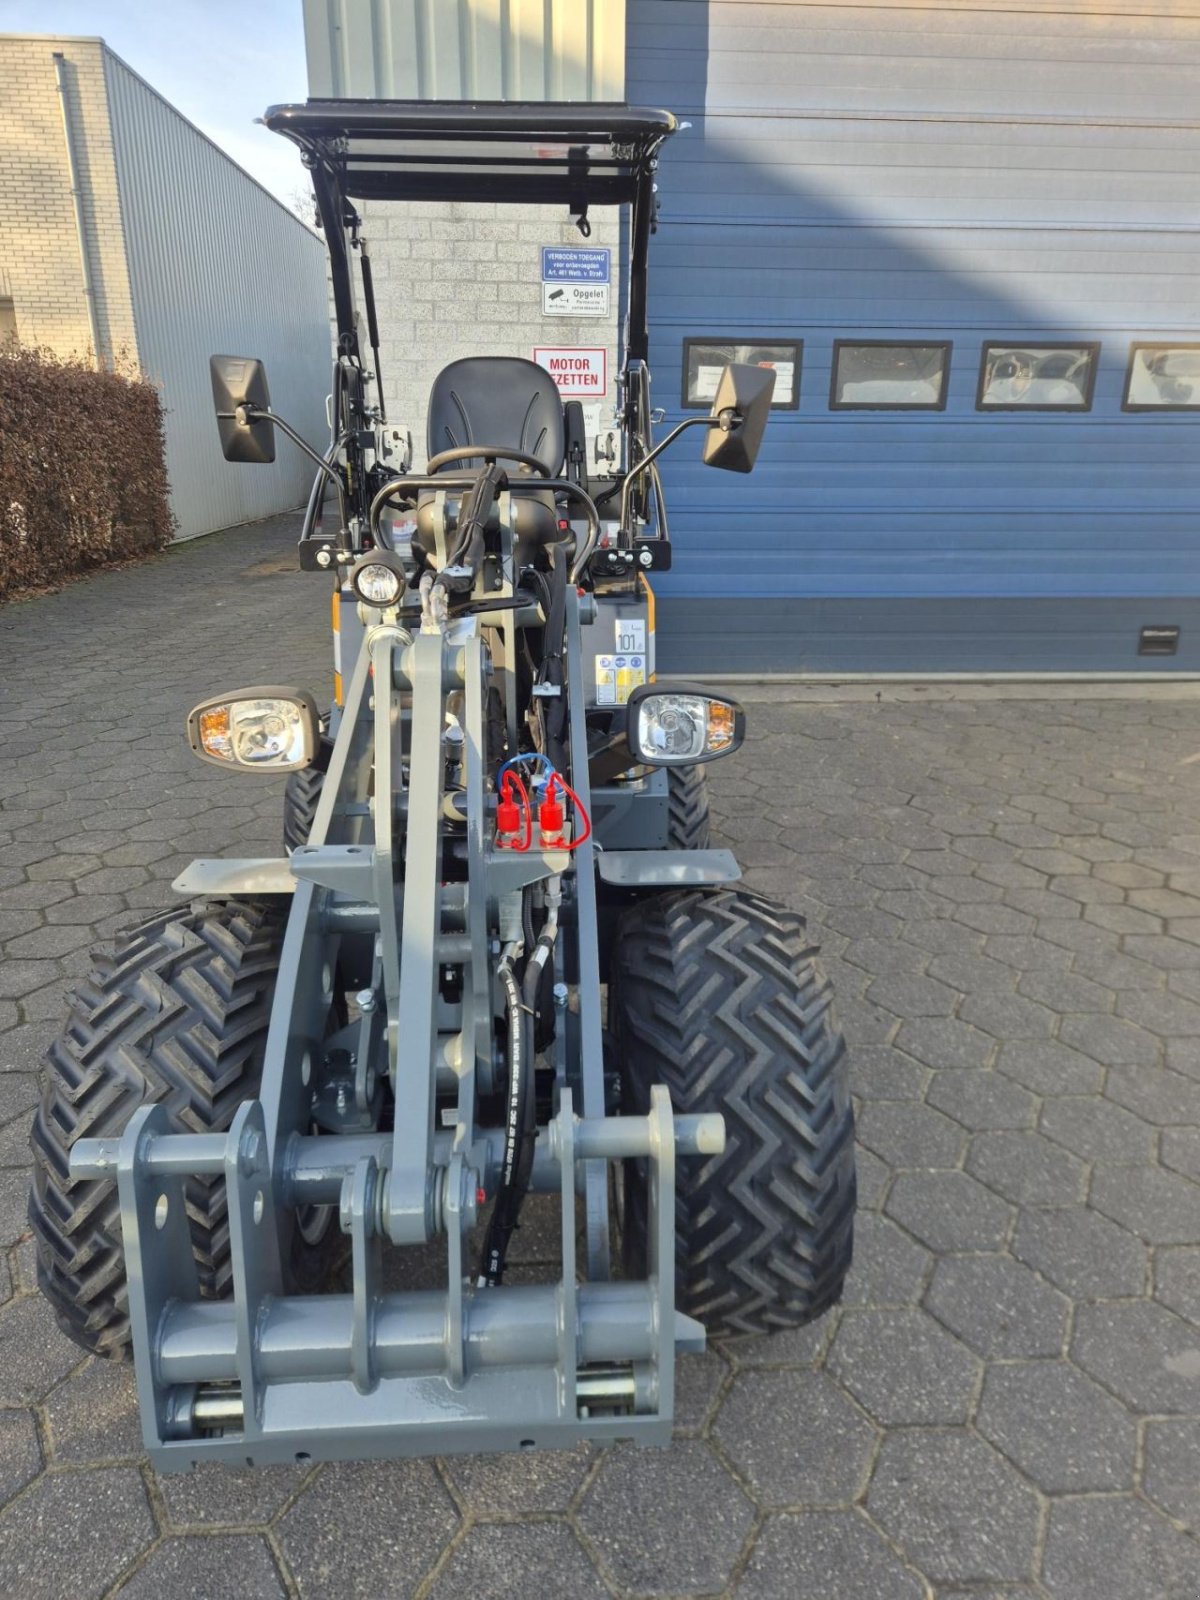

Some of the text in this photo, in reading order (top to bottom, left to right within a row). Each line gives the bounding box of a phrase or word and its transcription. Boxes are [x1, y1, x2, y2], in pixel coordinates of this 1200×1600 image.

[573, 288, 604, 299] Opgelet
[550, 359, 590, 370] MOTOR
[618, 634, 635, 650] 101
